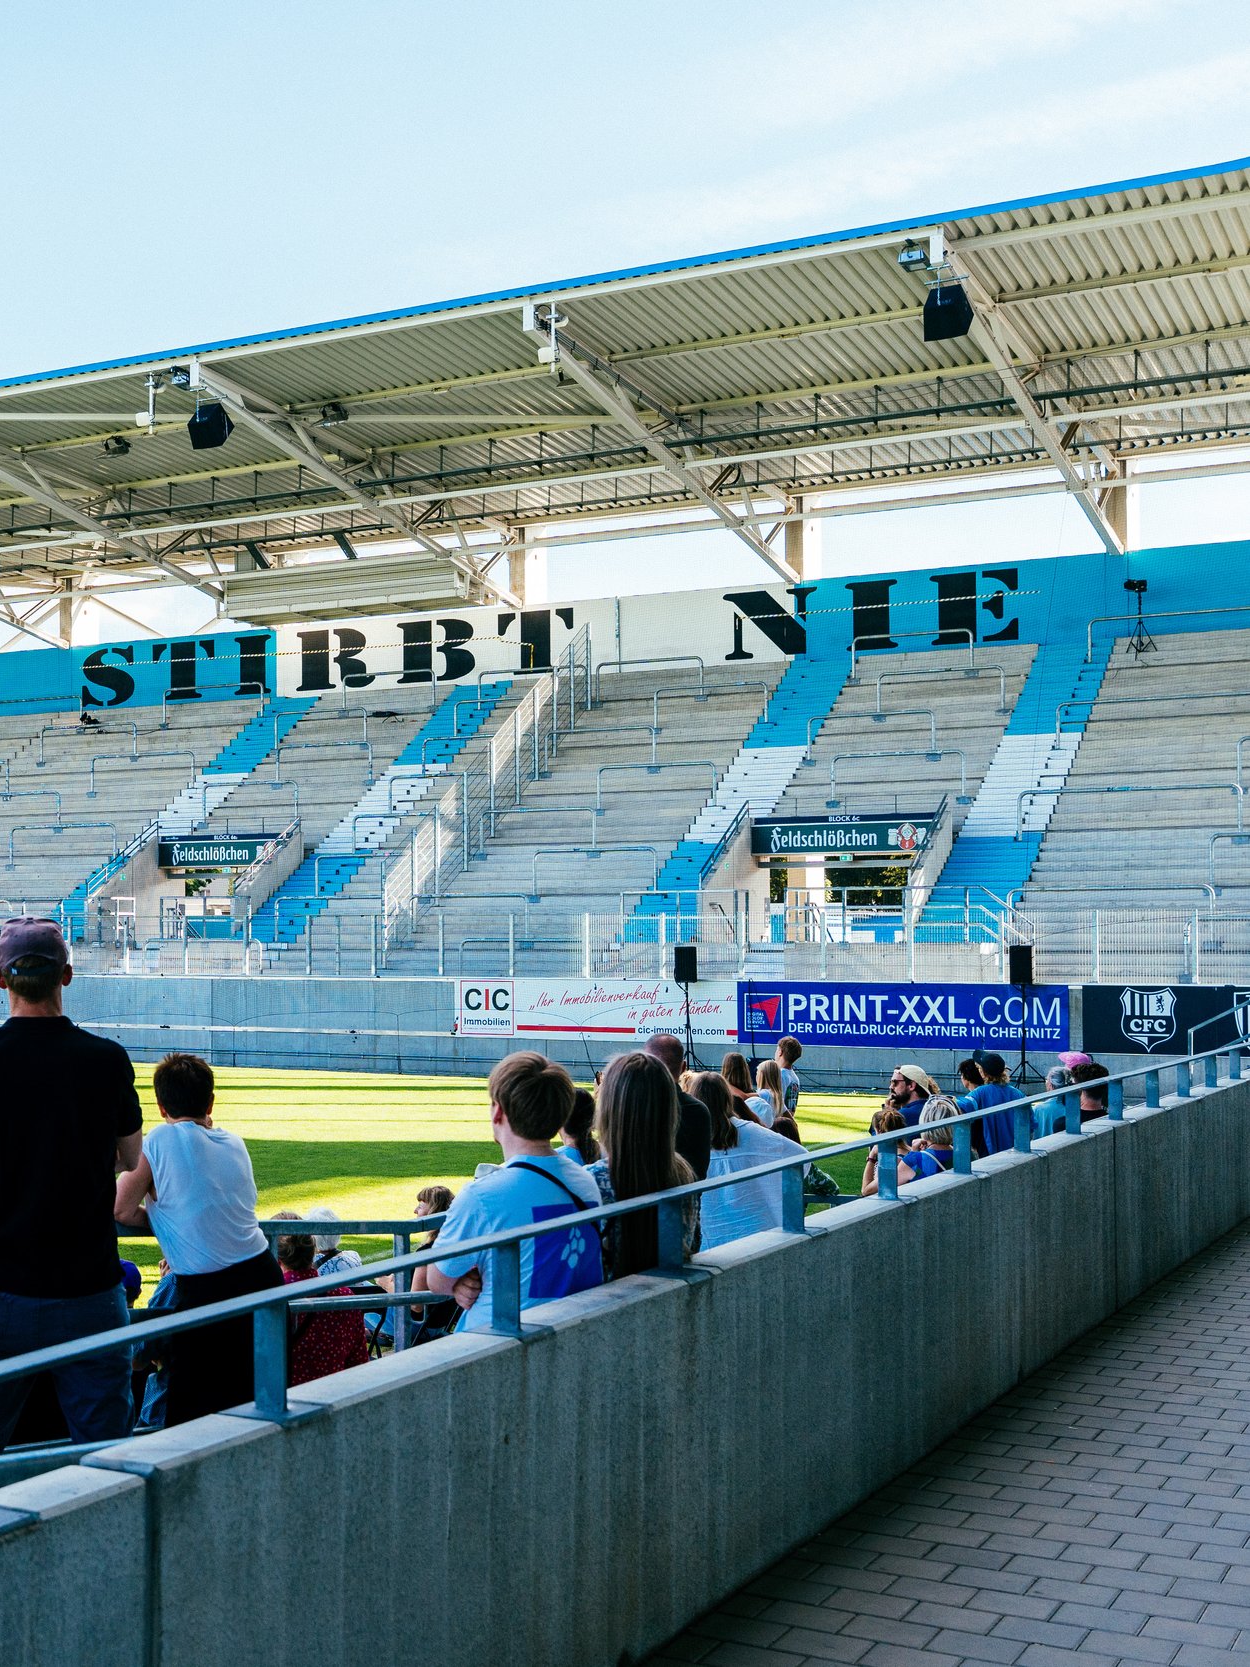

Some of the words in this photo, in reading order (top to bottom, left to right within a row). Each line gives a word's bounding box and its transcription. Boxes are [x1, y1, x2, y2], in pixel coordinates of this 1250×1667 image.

[80, 606, 574, 706] STIRBT
[723, 567, 1020, 661] NIE
[770, 827, 877, 852] Feldschlößchen
[172, 843, 249, 866] Feldschlößchen
[464, 988, 510, 1011] CIC
[560, 982, 661, 1006] Immobilienverkauf
[463, 1017, 511, 1026] Immobilien
[627, 1006, 638, 1020] in
[639, 1004, 674, 1025] guten
[788, 993, 1061, 1027] PRINT-XXL.COM
[788, 1023, 812, 1034] DER
[816, 1023, 968, 1038] DIGTALDRUCK-PARTNER
[971, 1026, 986, 1038] IN
[989, 1026, 1061, 1040] CHEMNITZ
[1129, 1018, 1167, 1033] CFC
